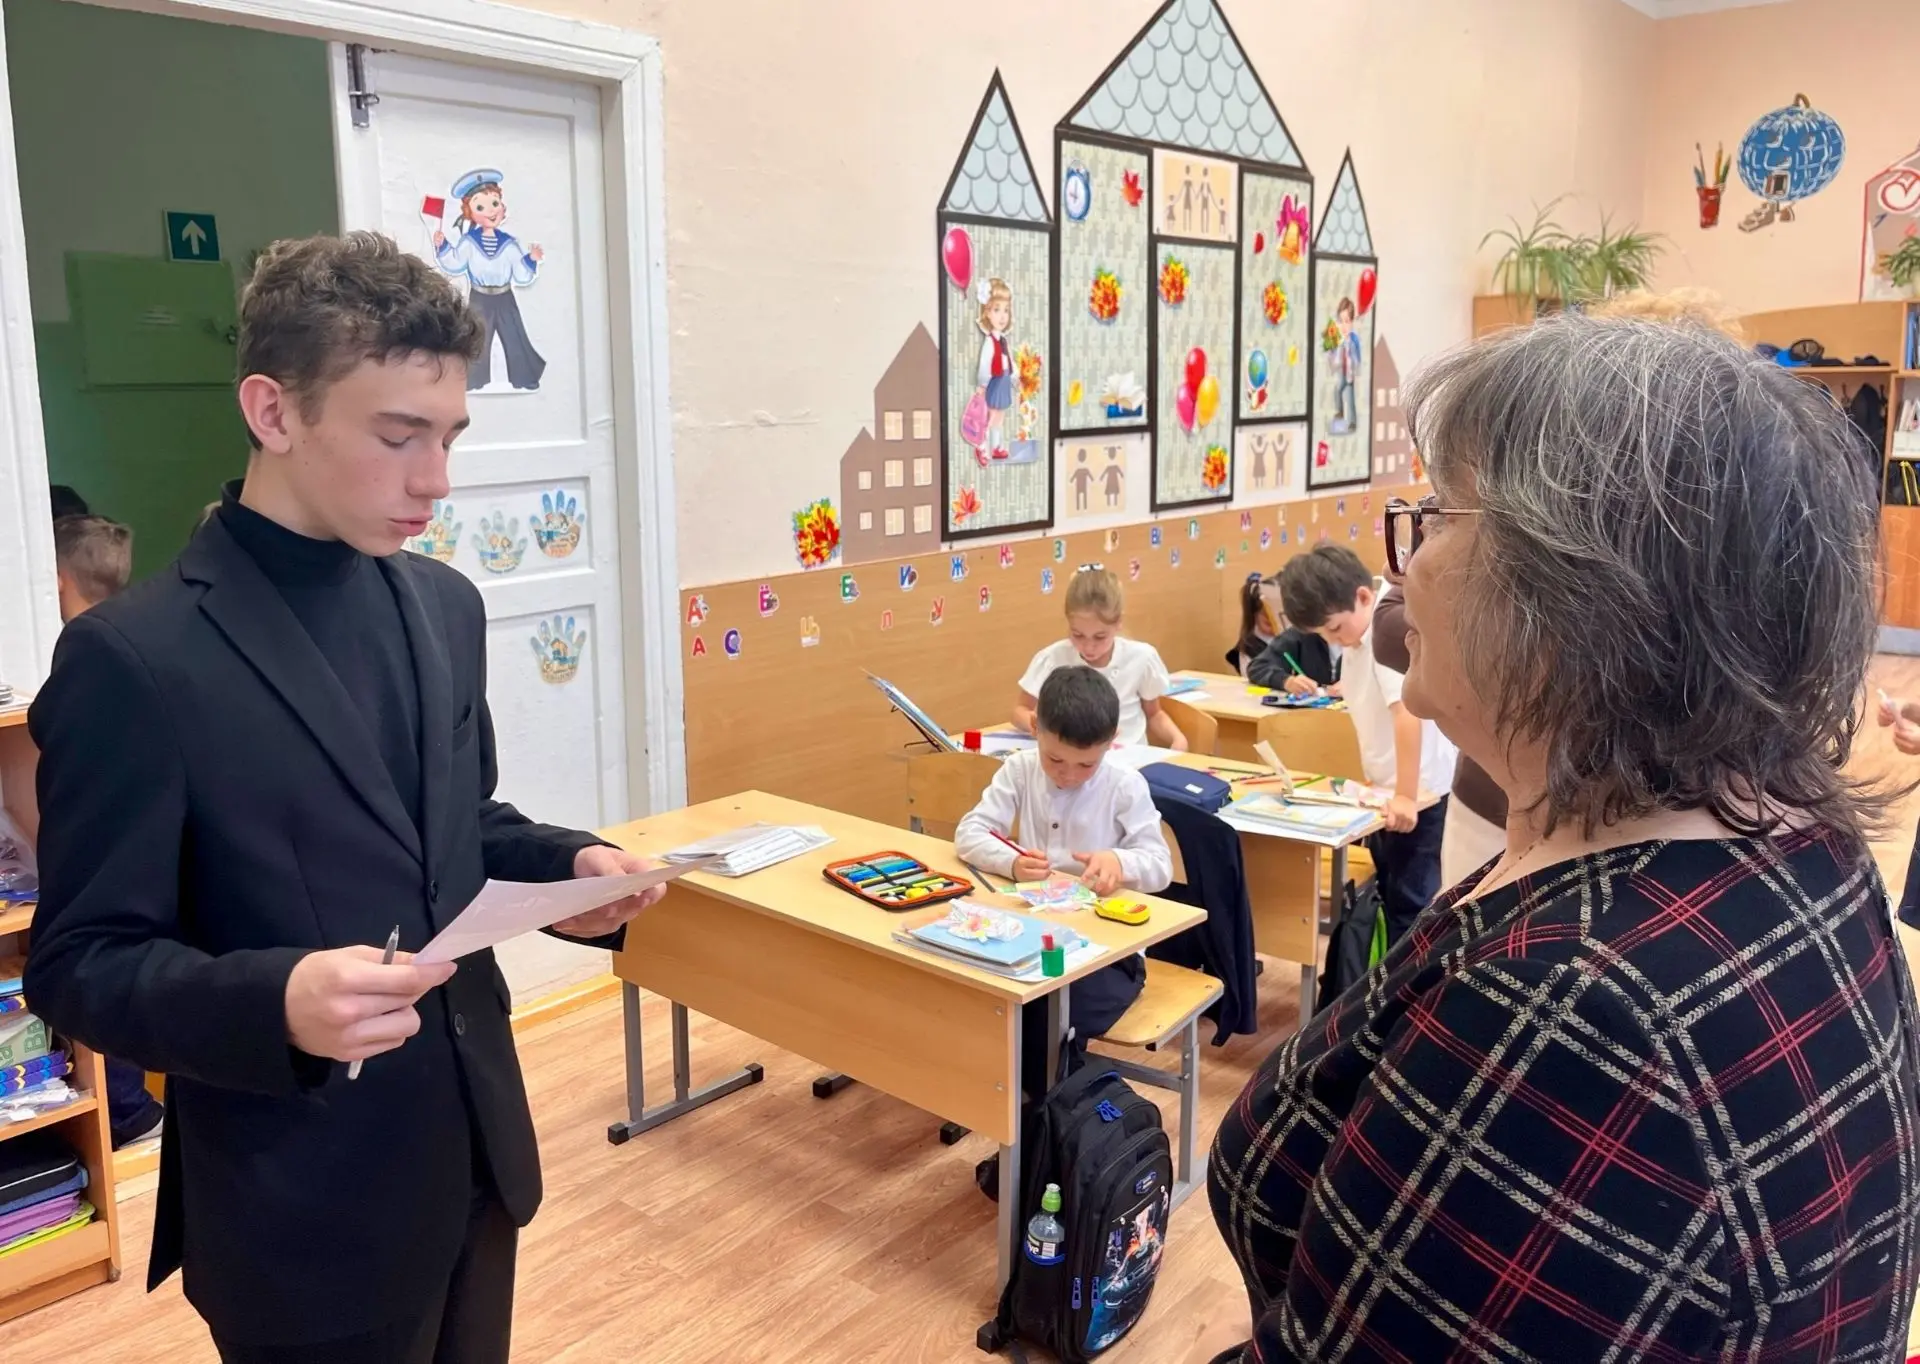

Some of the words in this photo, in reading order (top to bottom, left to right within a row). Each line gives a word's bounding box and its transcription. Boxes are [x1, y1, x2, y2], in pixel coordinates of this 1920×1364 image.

[951, 556, 965, 578] Ж
[687, 595, 705, 622] А
[692, 637, 706, 656] А
[725, 629, 740, 654] С
